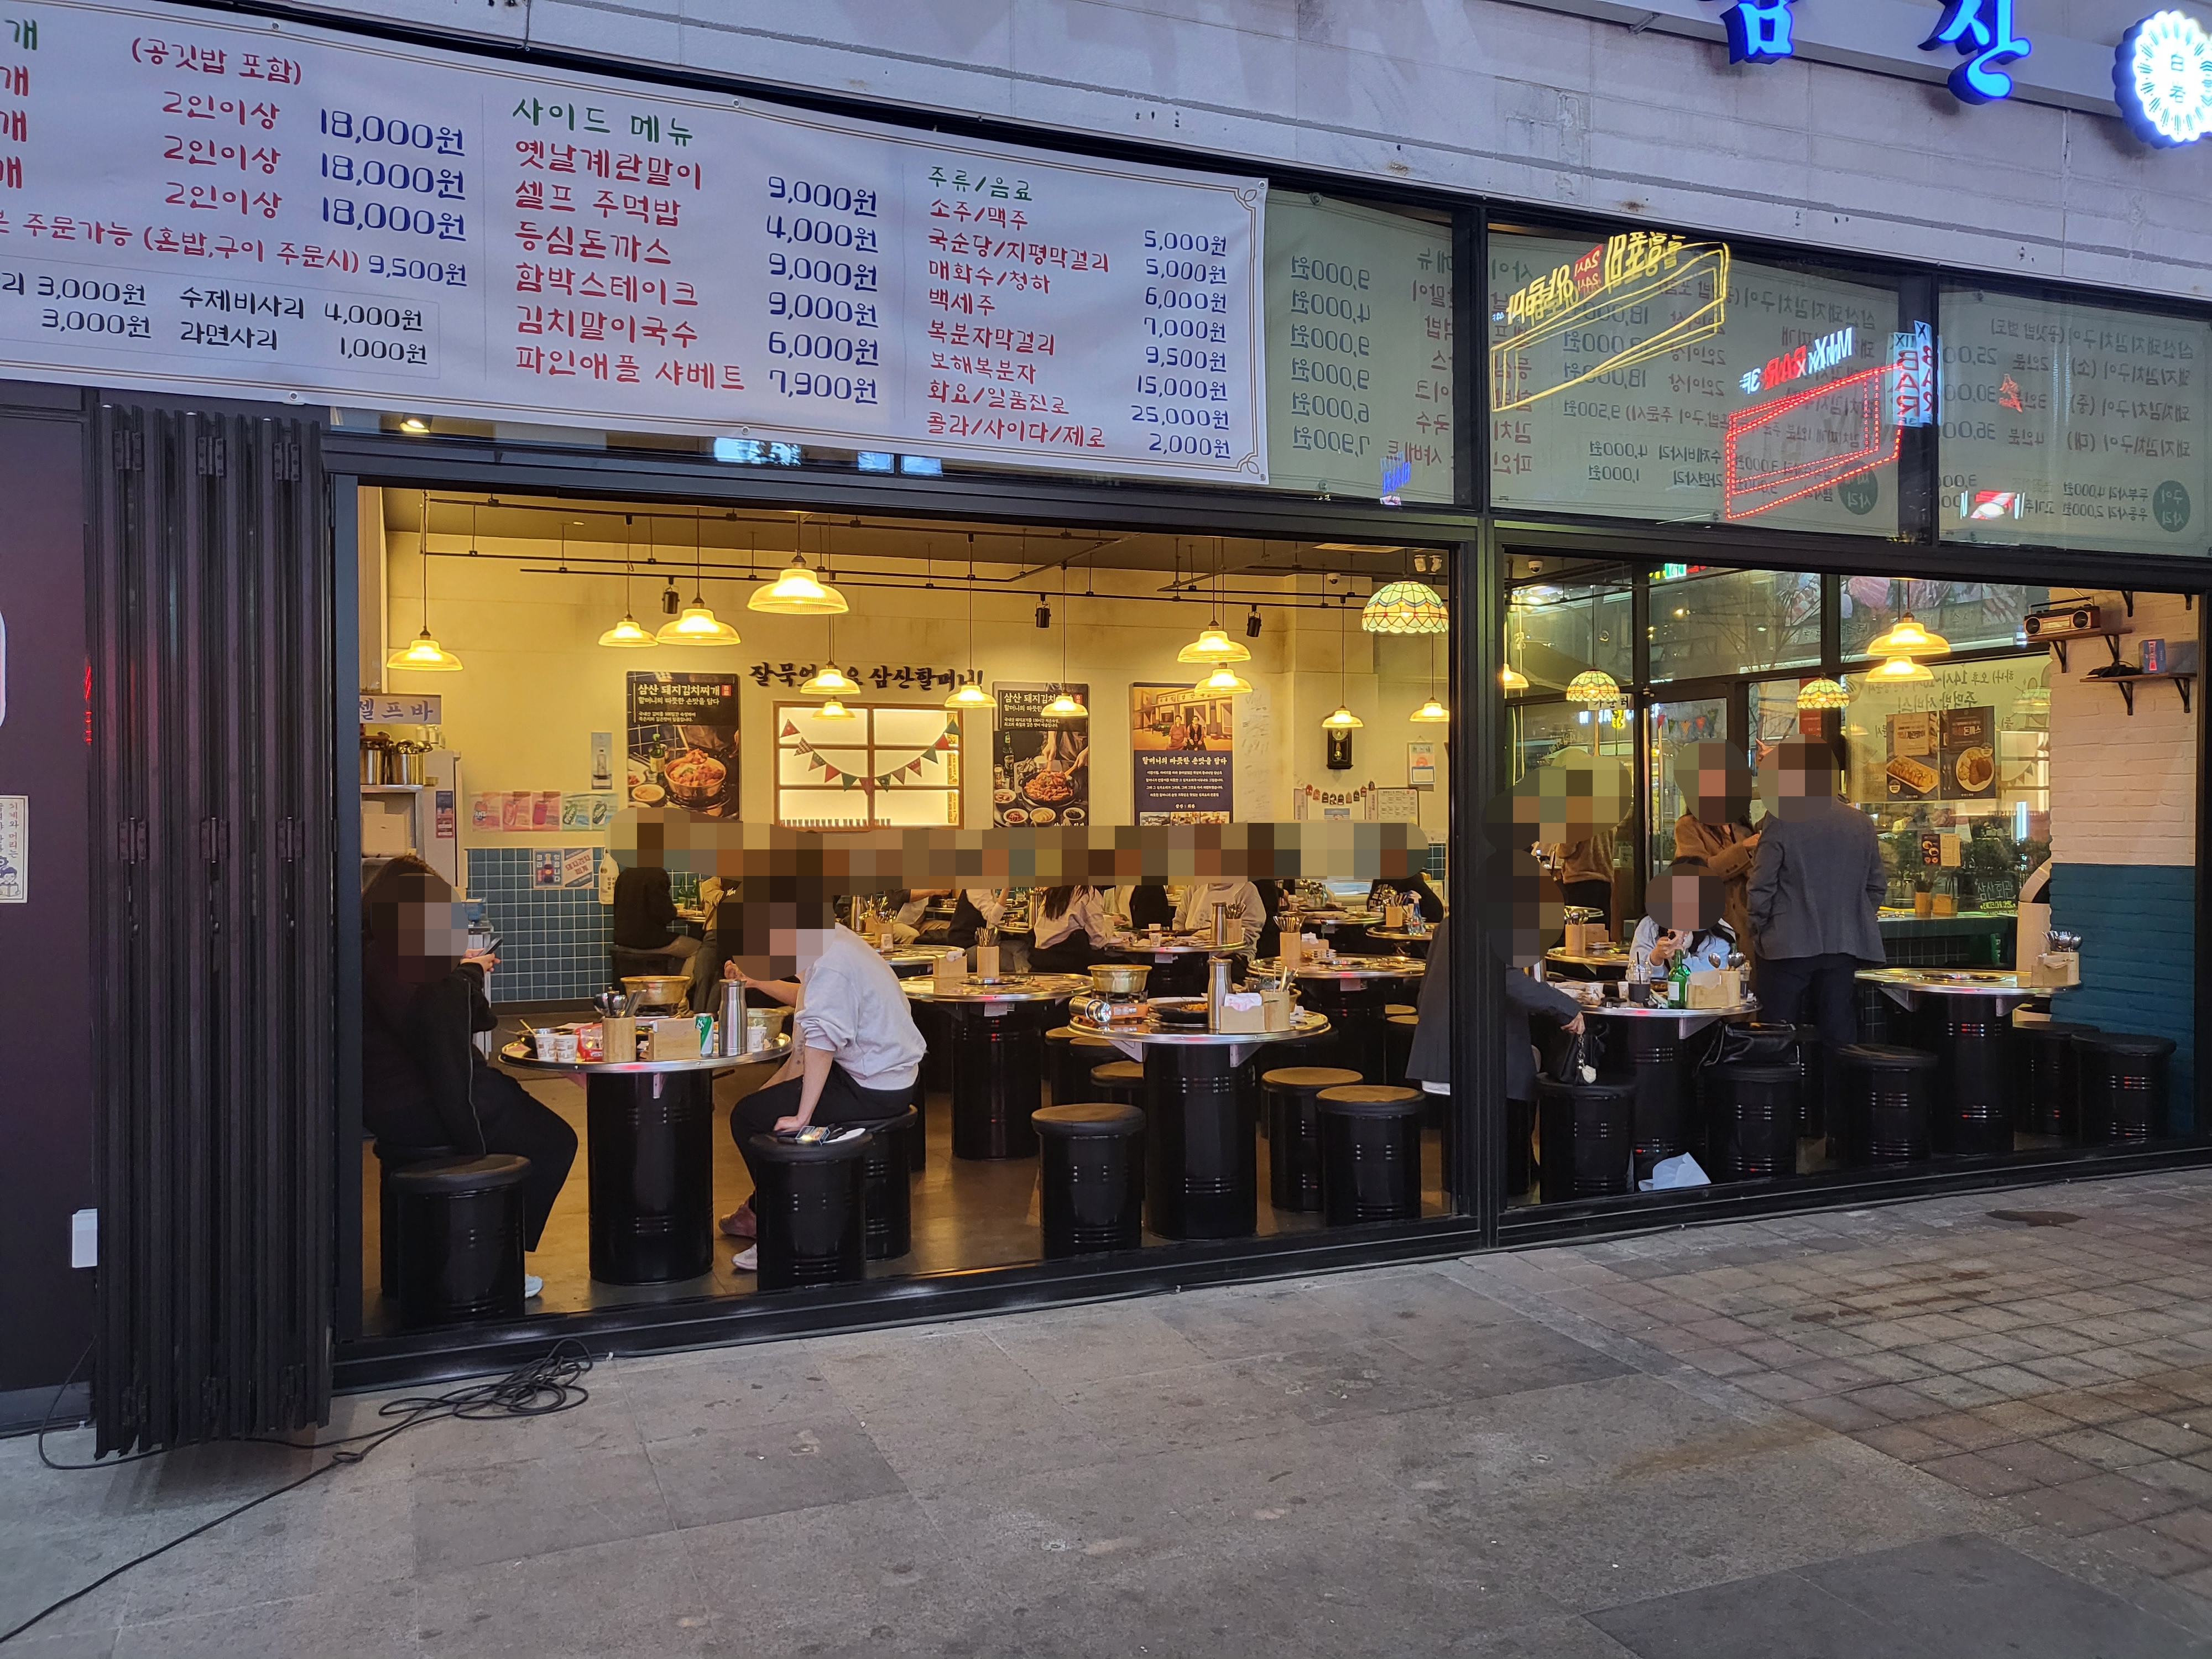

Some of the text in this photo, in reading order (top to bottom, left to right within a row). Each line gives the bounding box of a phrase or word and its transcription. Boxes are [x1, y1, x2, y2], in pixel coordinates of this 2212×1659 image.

[132, 37, 225, 75] (공깃밥
[238, 53, 302, 85] 포함)
[163, 91, 280, 129] 2인이상
[321, 108, 465, 157] 18,000원
[512, 97, 693, 147] 사이드 메뉴
[163, 135, 281, 175] 2인이상
[321, 152, 466, 200] 18,000원
[516, 139, 878, 217] 옛날계란말이 9,000원
[928, 166, 1032, 201] 주류/음료
[165, 182, 283, 220] 2인이상
[322, 196, 467, 242] 18,000원
[515, 180, 879, 254] 셀프 주먹밥 4,000원
[930, 199, 1227, 257] 소주/맥주 5,000원
[23, 213, 133, 247] 주문가능
[144, 226, 264, 262] (혼밥,구이
[276, 242, 359, 274] 주문시)
[368, 254, 468, 288] 9,500원
[515, 220, 878, 293] 등심돈까스 9,000원
[928, 228, 1227, 284] 국순당/지평막걸리 5,000원
[38, 276, 147, 306] 3,000원
[179, 287, 305, 319] 수제비사리
[325, 302, 424, 332] 4,000원
[516, 262, 879, 328] 함박스테이크 9,000원
[928, 260, 1227, 314] 매화수/청하 6,000원
[41, 309, 429, 365] 3,000원 라면사리 1,000원
[517, 305, 879, 367] 김치말이국수 6,000원
[929, 288, 1227, 343] 백세주 7,000원
[927, 320, 1227, 372] 복분자막걸리 9,500원
[516, 346, 878, 405] 파인애플 샤베트 7,900원
[930, 351, 1228, 401] 보해복분자 15,000원
[927, 380, 1229, 430] 화요/일품진로 25,000원
[927, 411, 1231, 459] 콜라/사이다/제로 2,000원
[638, 684, 659, 696] 삼산
[661, 684, 720, 696] 돼지김치찌개
[1004, 692, 1022, 703] 삼산
[1024, 693, 1062, 704] 돼지김치
